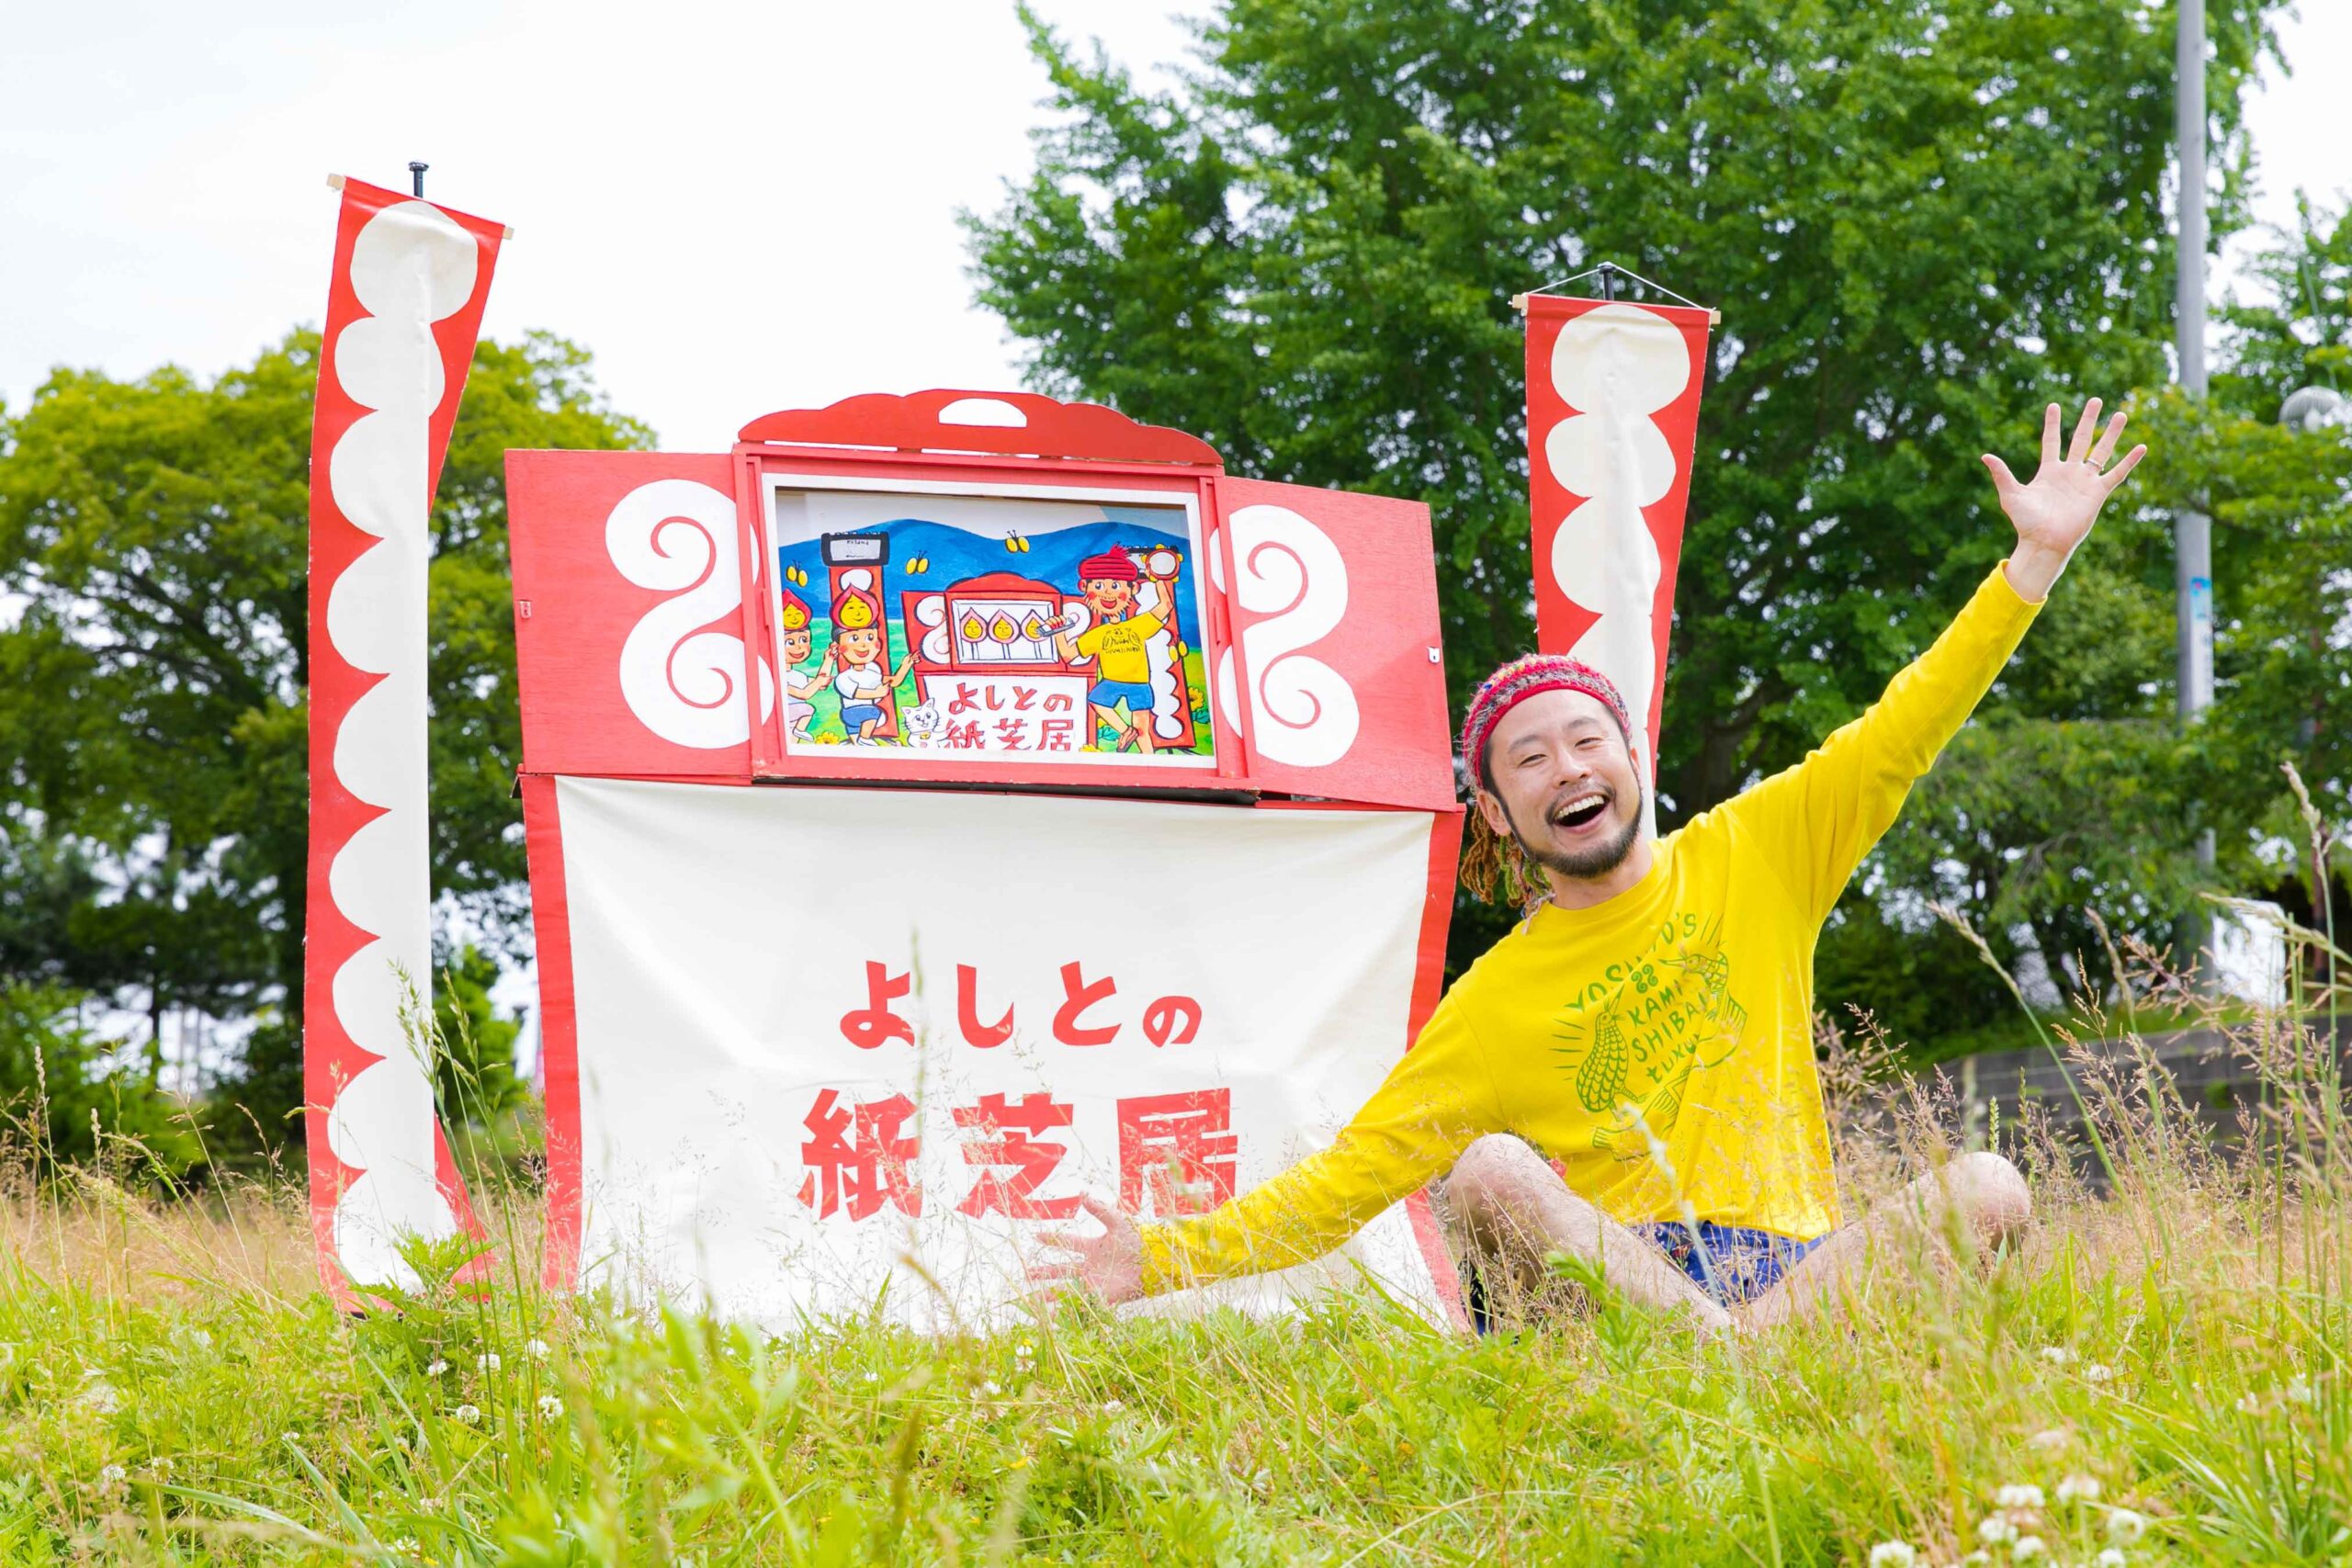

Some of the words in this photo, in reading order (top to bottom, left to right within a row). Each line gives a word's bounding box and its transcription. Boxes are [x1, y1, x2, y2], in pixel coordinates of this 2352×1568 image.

[948, 682, 1073, 715] よしとの
[944, 717, 1074, 751] 紙芝居
[839, 960, 1203, 1049] よしとの
[1626, 979, 1683, 1029] KAMI
[1632, 992, 1707, 1062] SHIBAI
[797, 1087, 1238, 1222] 紙芝居
